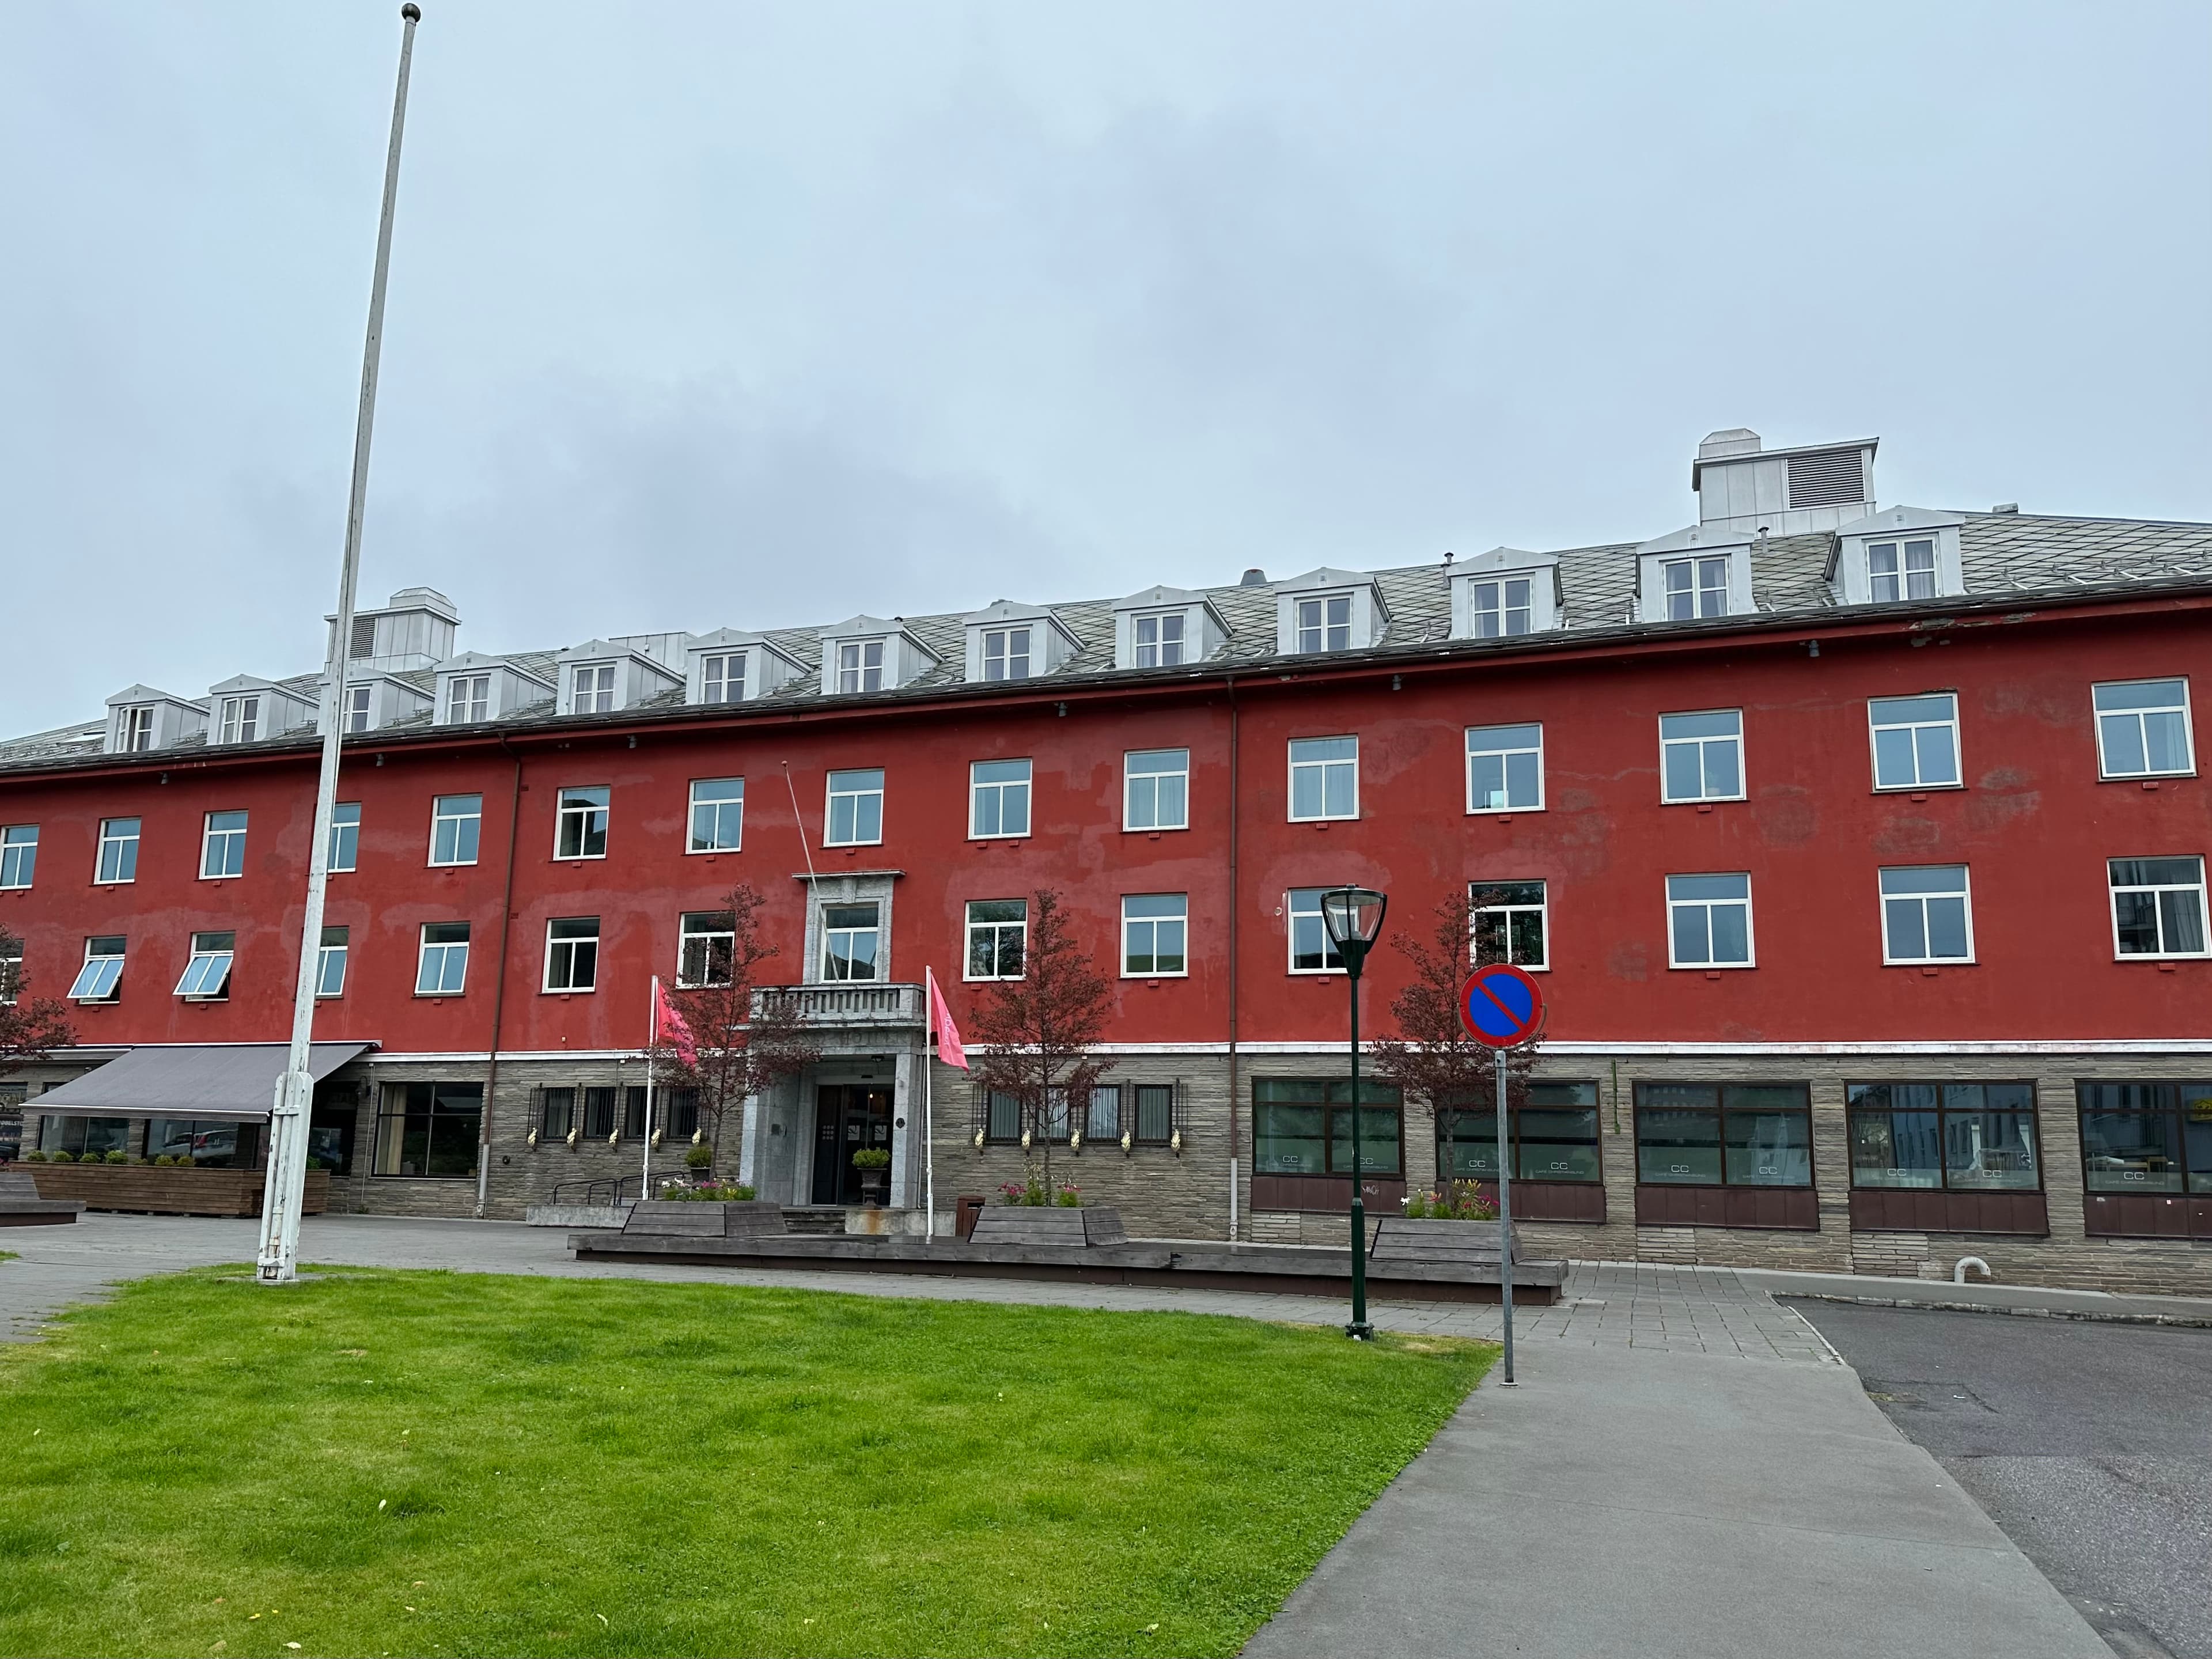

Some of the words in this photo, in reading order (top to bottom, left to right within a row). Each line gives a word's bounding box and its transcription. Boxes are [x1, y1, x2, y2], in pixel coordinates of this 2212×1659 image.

[1551, 1162, 1568, 1170] CC
[1671, 1165, 1689, 1173] CC
[1759, 1166, 1778, 1175] CC
[1887, 1168, 1907, 1176] CC
[1982, 1170, 2002, 1178] CC
[2124, 1172, 2145, 1180] CC
